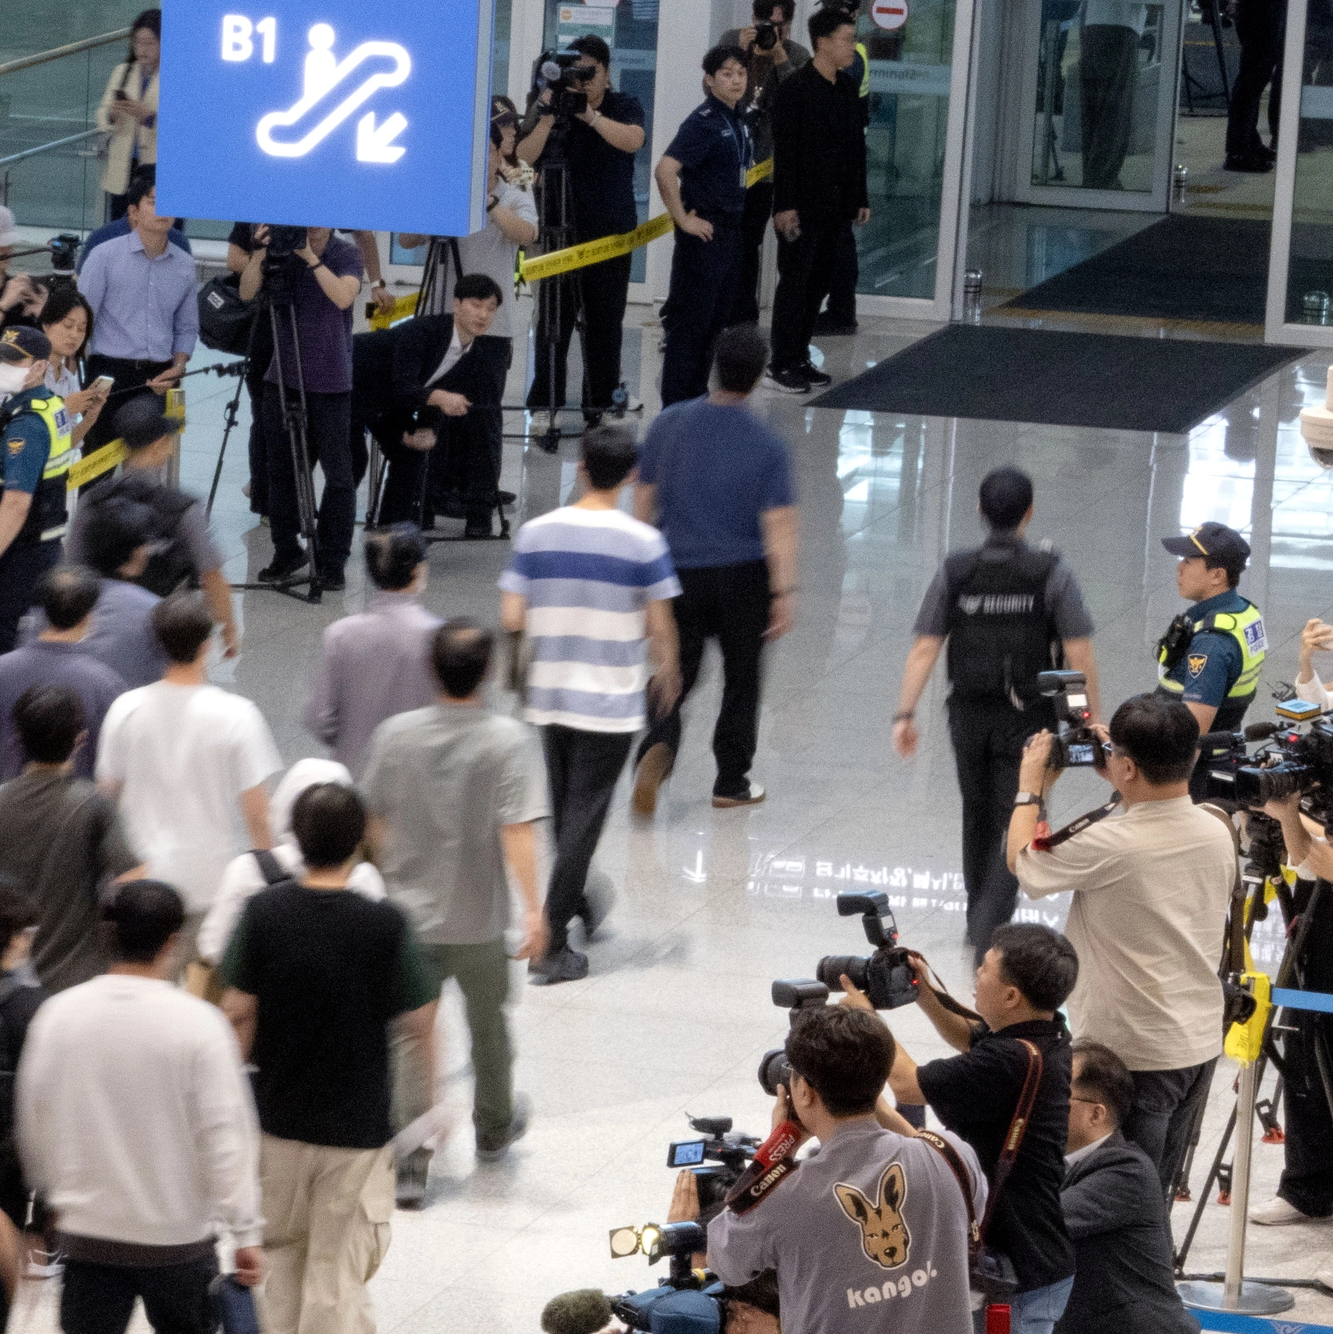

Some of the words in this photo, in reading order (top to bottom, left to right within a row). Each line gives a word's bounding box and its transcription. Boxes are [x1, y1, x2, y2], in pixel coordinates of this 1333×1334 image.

[221, 14, 276, 63] B1
[983, 594, 1034, 614] SECURITY
[768, 1133, 795, 1162] PRESS
[750, 1164, 787, 1197] Canon
